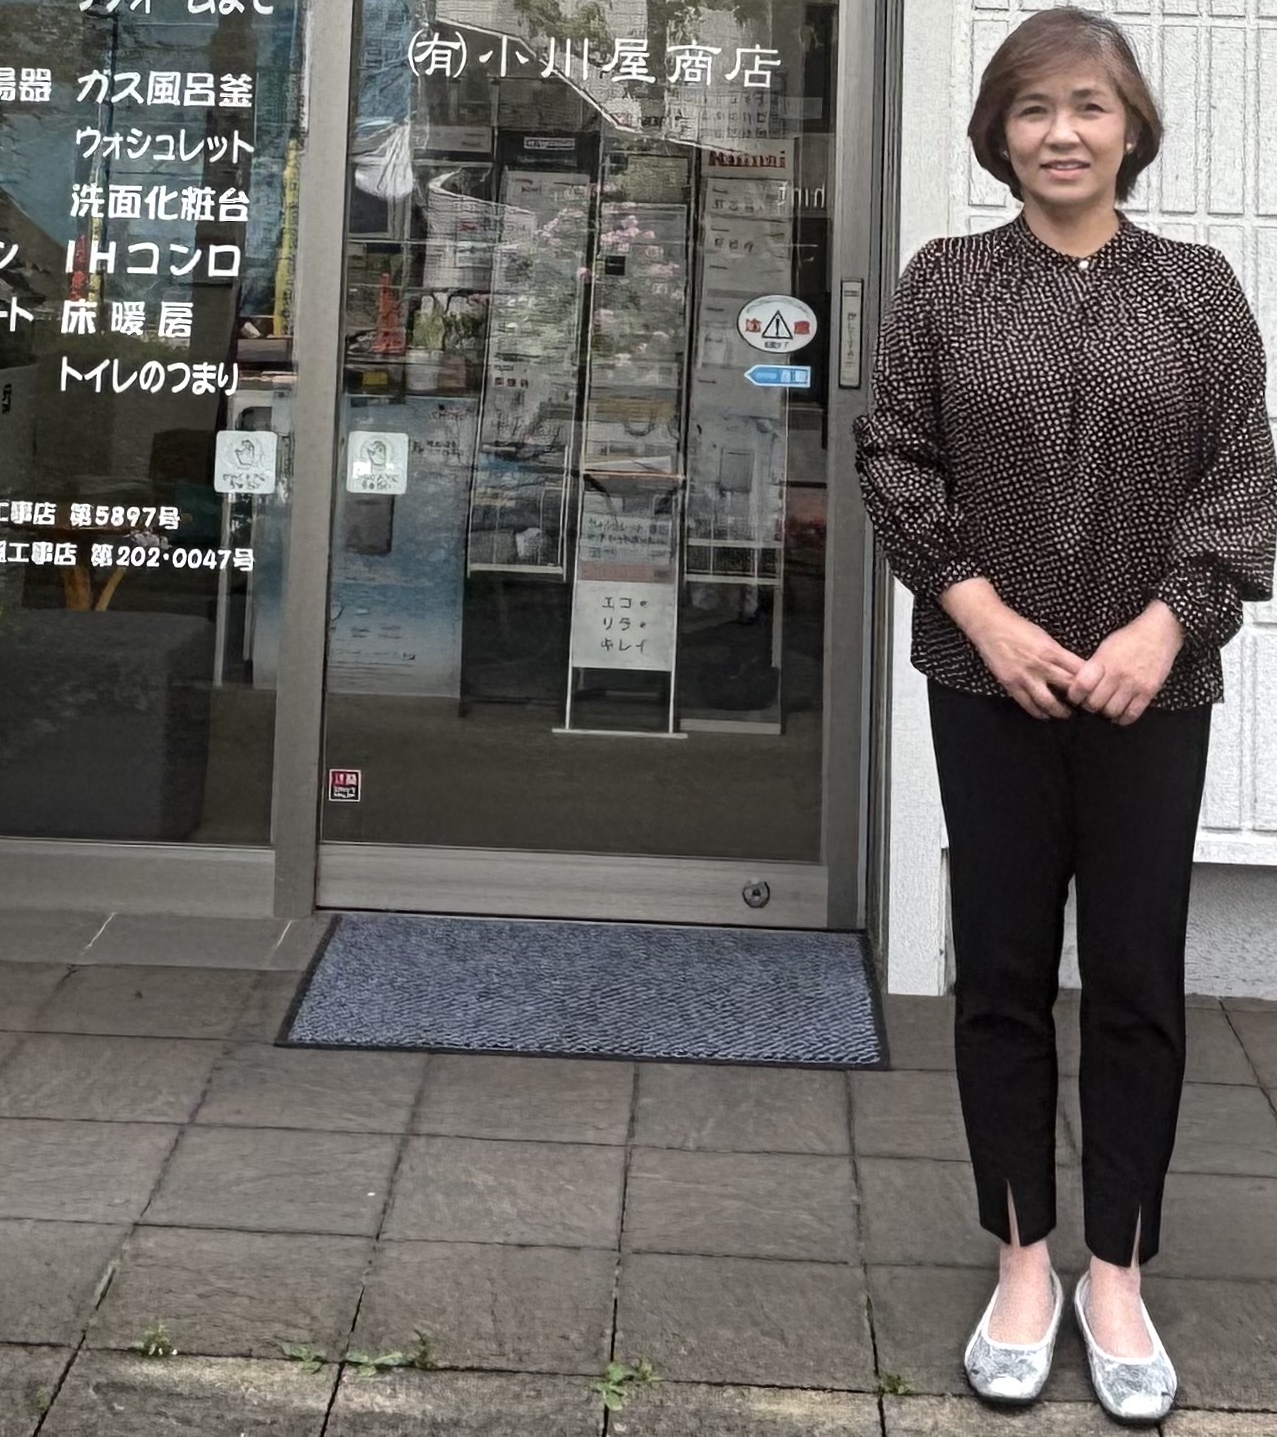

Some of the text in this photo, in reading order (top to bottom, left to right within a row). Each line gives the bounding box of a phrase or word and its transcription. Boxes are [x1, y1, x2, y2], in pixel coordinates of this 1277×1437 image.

[76, 68, 254, 108] ガス風呂釜
[75, 125, 255, 164] ウォシュレット
[69, 183, 251, 223] 洗面化粧台
[65, 239, 241, 277] IHコンロ
[60, 298, 194, 338] 床暖房
[60, 356, 239, 396] トイレのつまり
[69, 502, 181, 530] 第5897号
